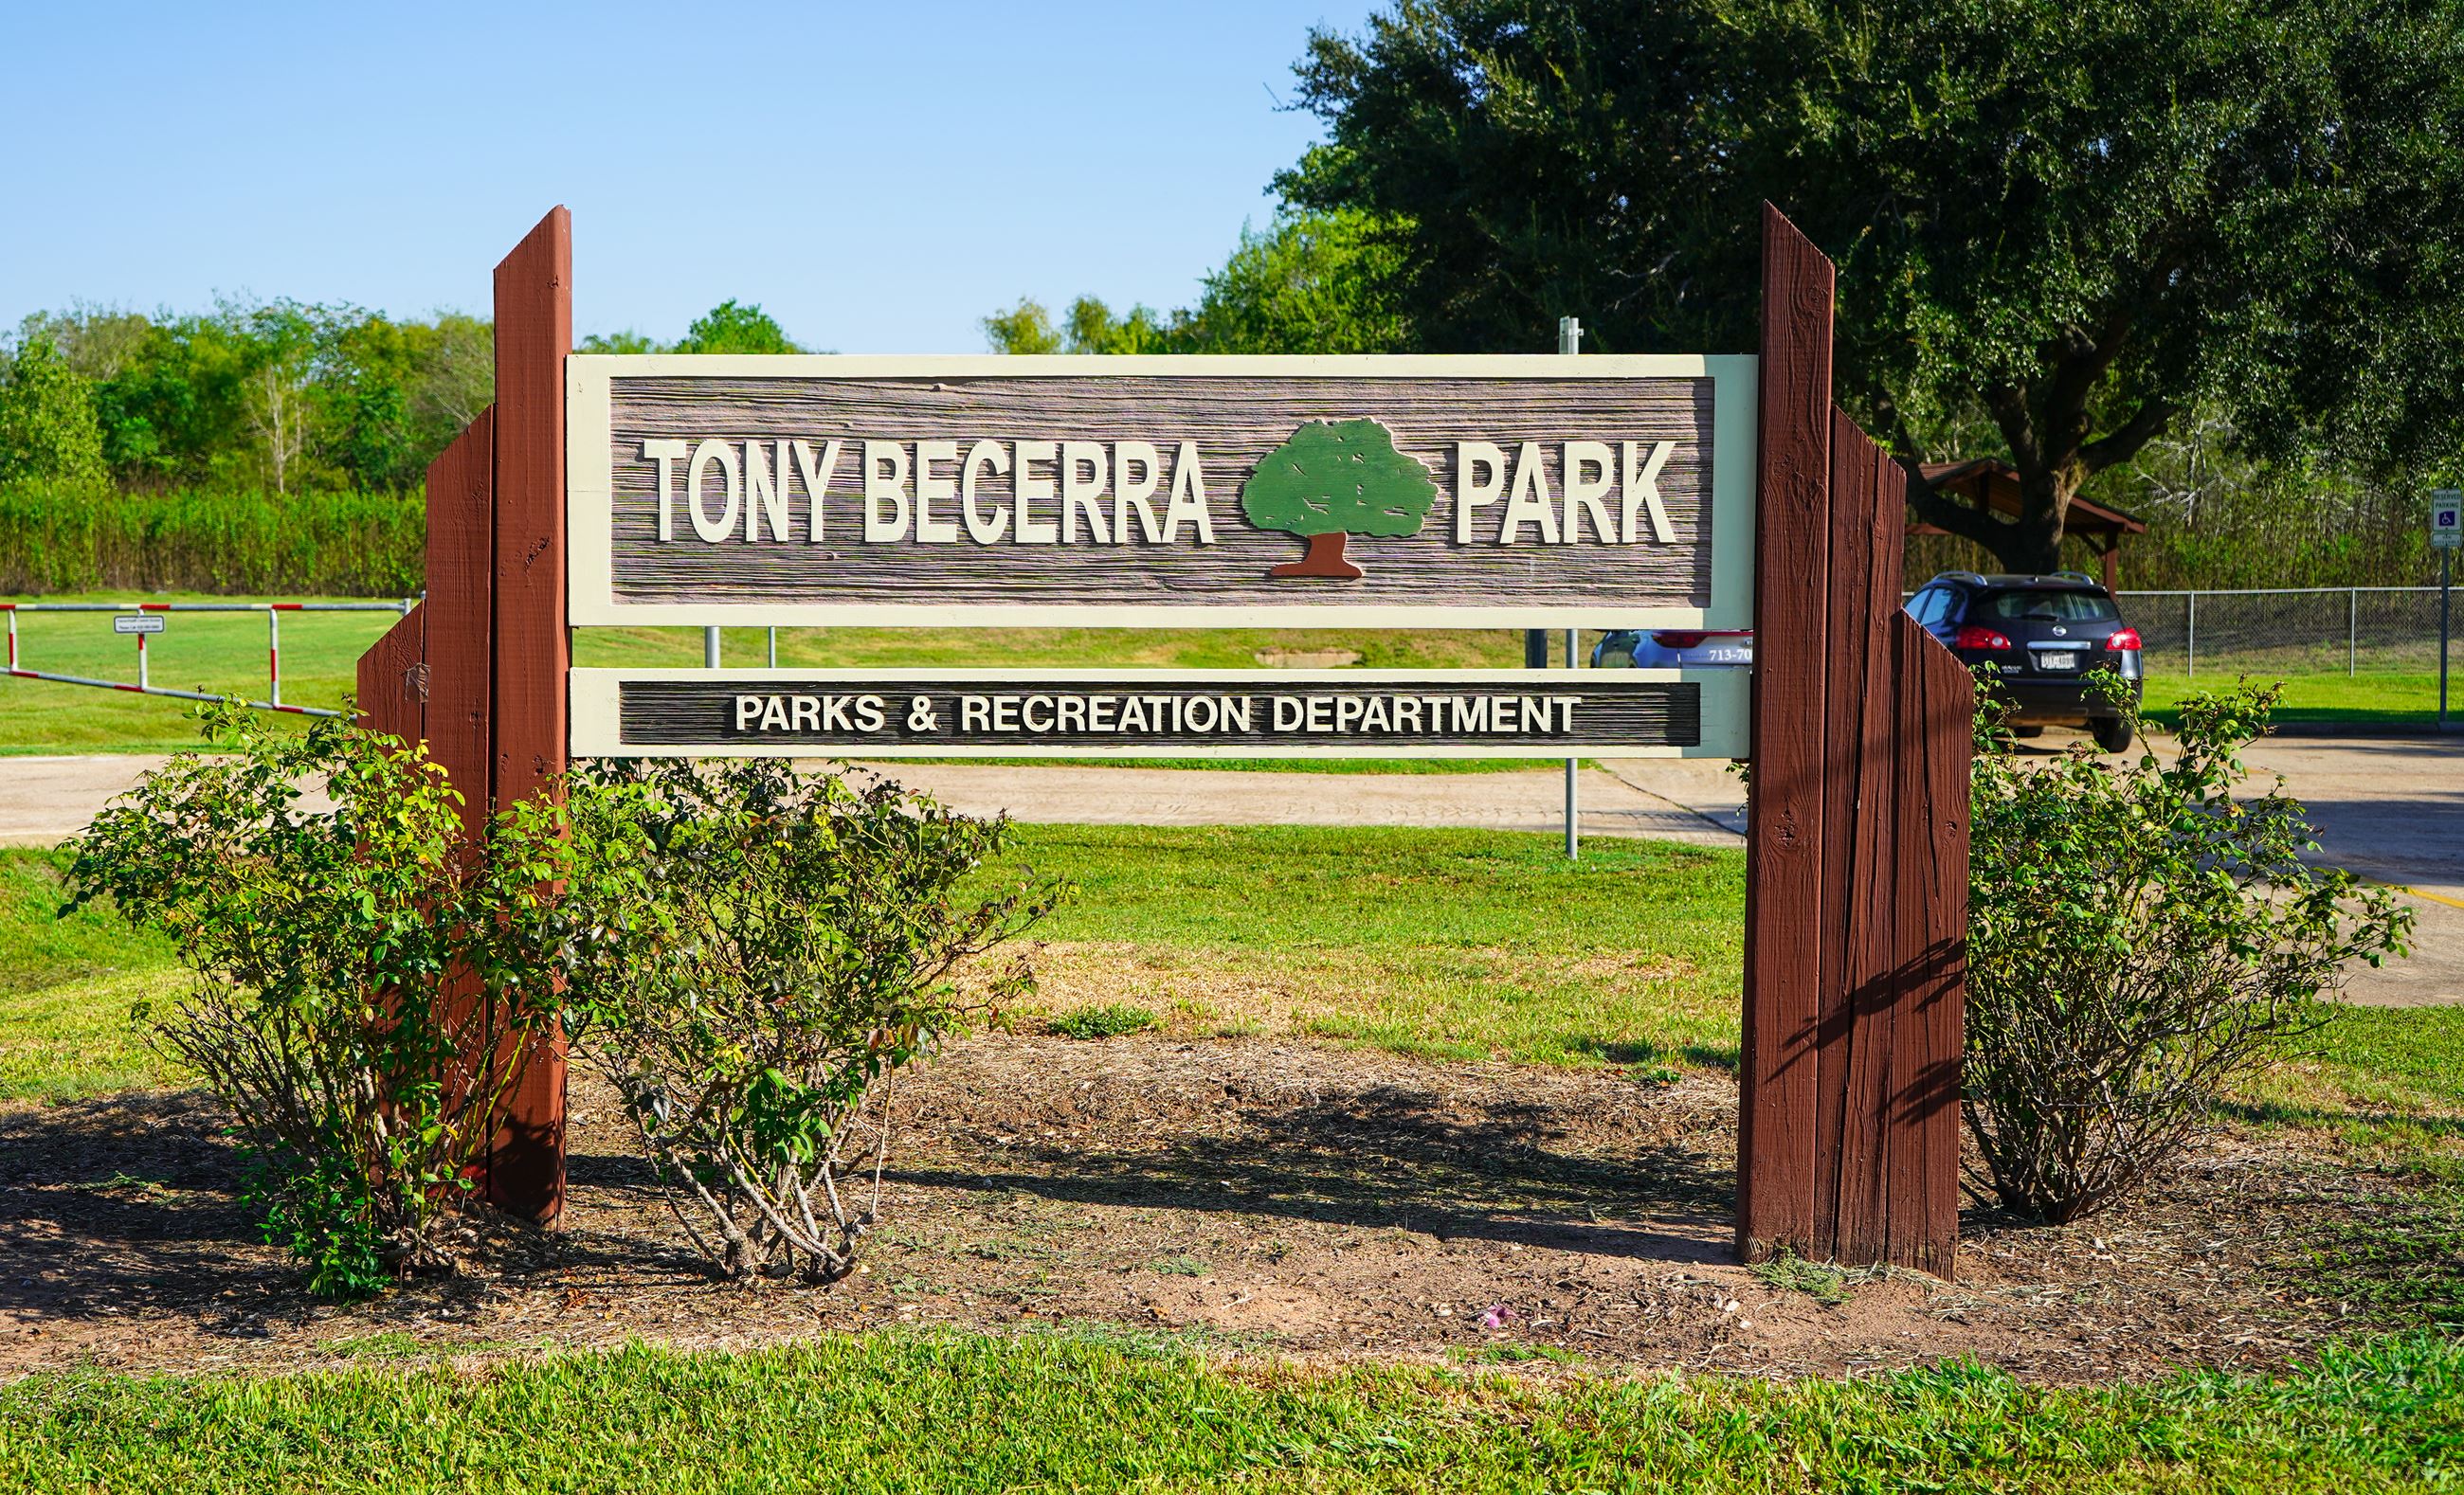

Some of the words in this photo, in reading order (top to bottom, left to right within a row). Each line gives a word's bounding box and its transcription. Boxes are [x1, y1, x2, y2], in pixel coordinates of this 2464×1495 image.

[643, 438, 842, 543] TONY
[863, 438, 1216, 545] BECERRA
[1455, 440, 1677, 545] PARK
[734, 694, 884, 732] PARKS
[907, 695, 937, 732] &
[961, 694, 1251, 732] RECREATION
[1273, 695, 1582, 732] DEPARTMENT
